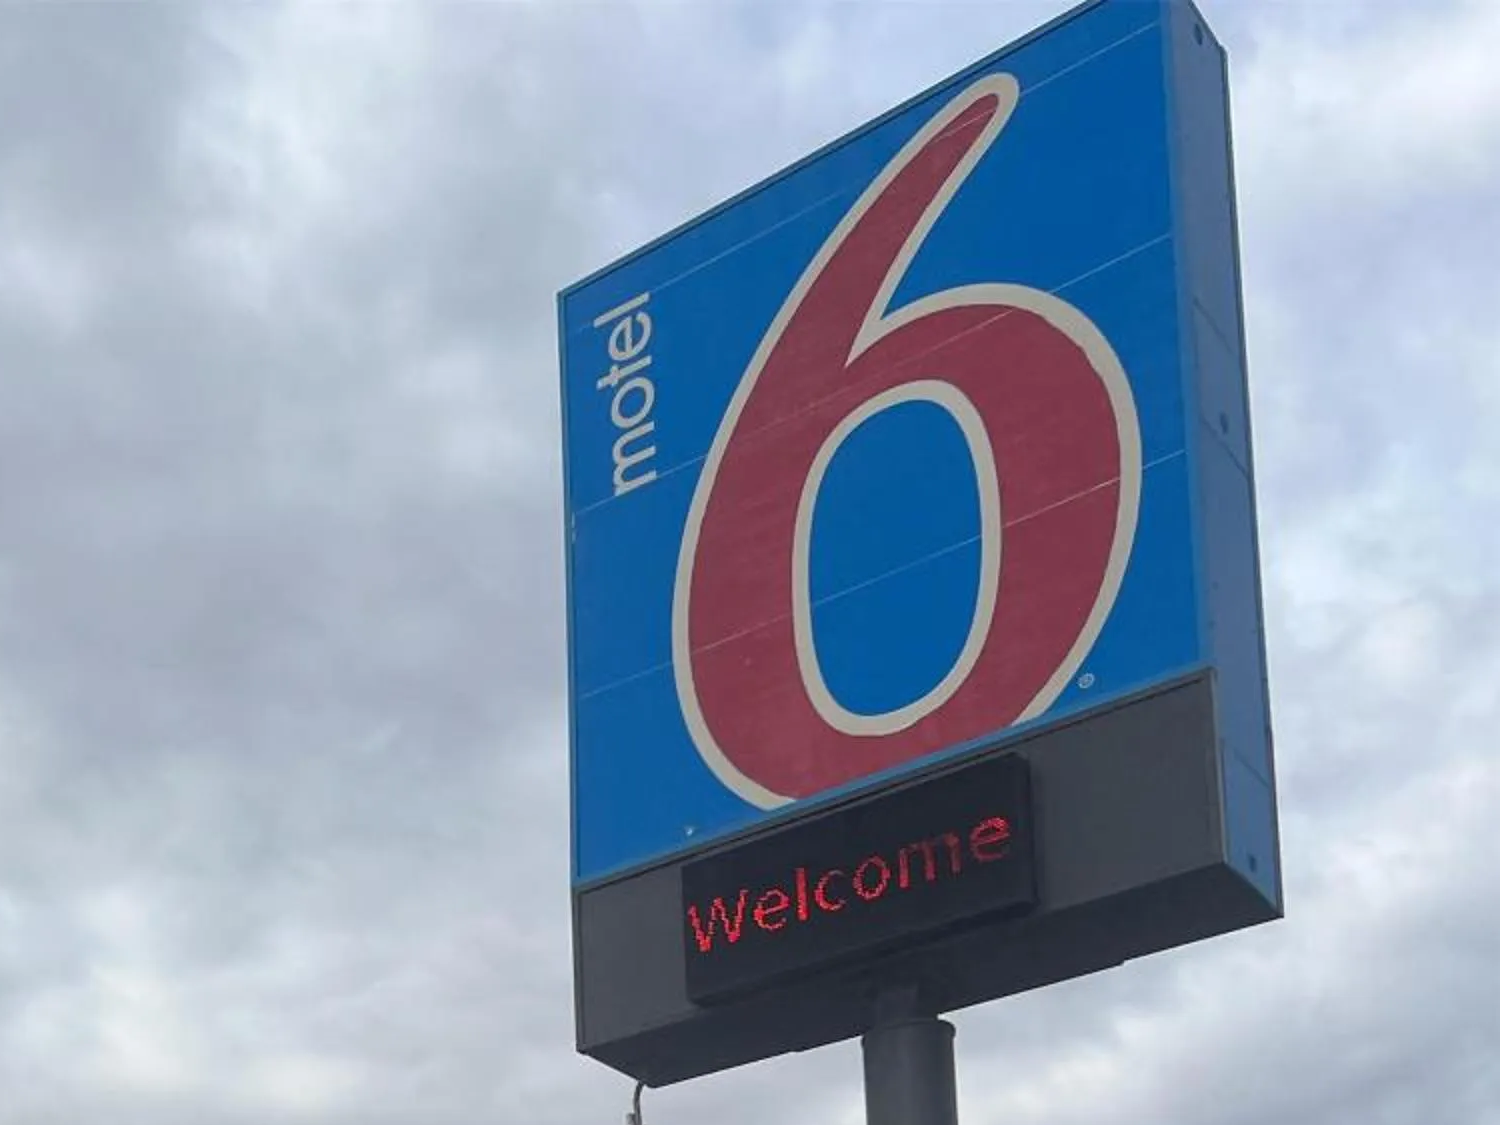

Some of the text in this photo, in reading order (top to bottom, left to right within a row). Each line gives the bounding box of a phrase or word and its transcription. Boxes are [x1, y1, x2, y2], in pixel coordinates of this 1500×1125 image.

[593, 291, 657, 497] motel
[671, 72, 1142, 810] 6
[687, 815, 1011, 953] Welcome
